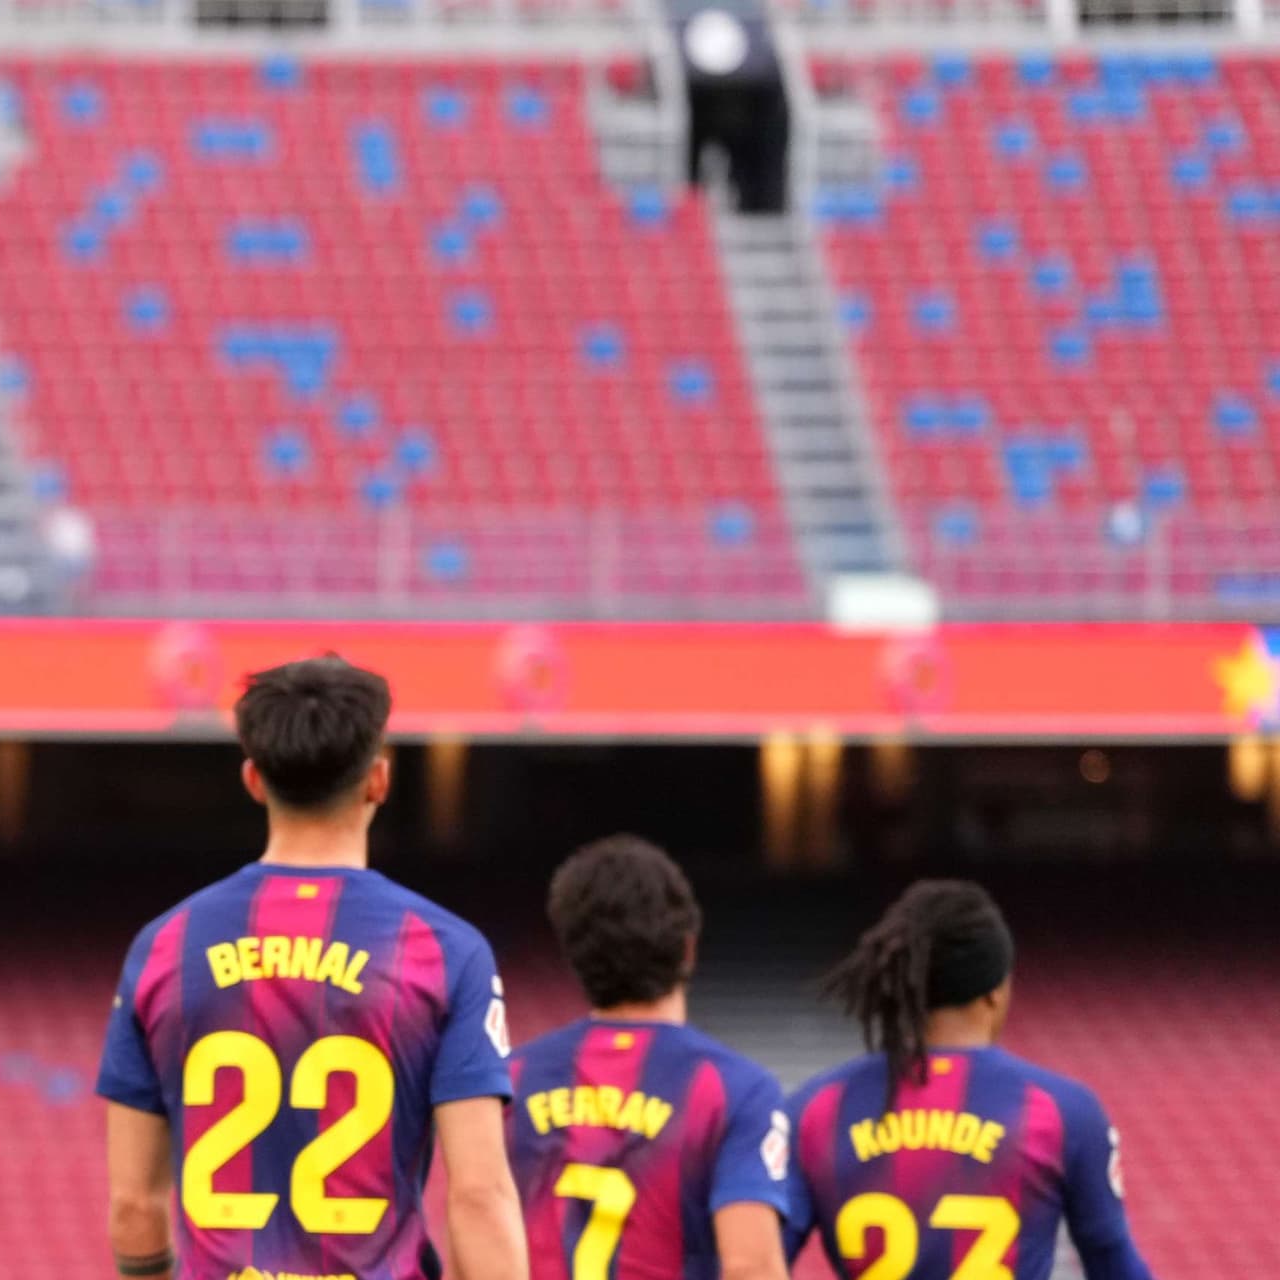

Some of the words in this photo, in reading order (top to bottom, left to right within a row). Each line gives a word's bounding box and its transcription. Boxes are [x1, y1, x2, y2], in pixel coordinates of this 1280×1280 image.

[206, 934, 370, 995] BERNAL
[181, 1030, 396, 1235] 22
[526, 1085, 673, 1139] FERRAN
